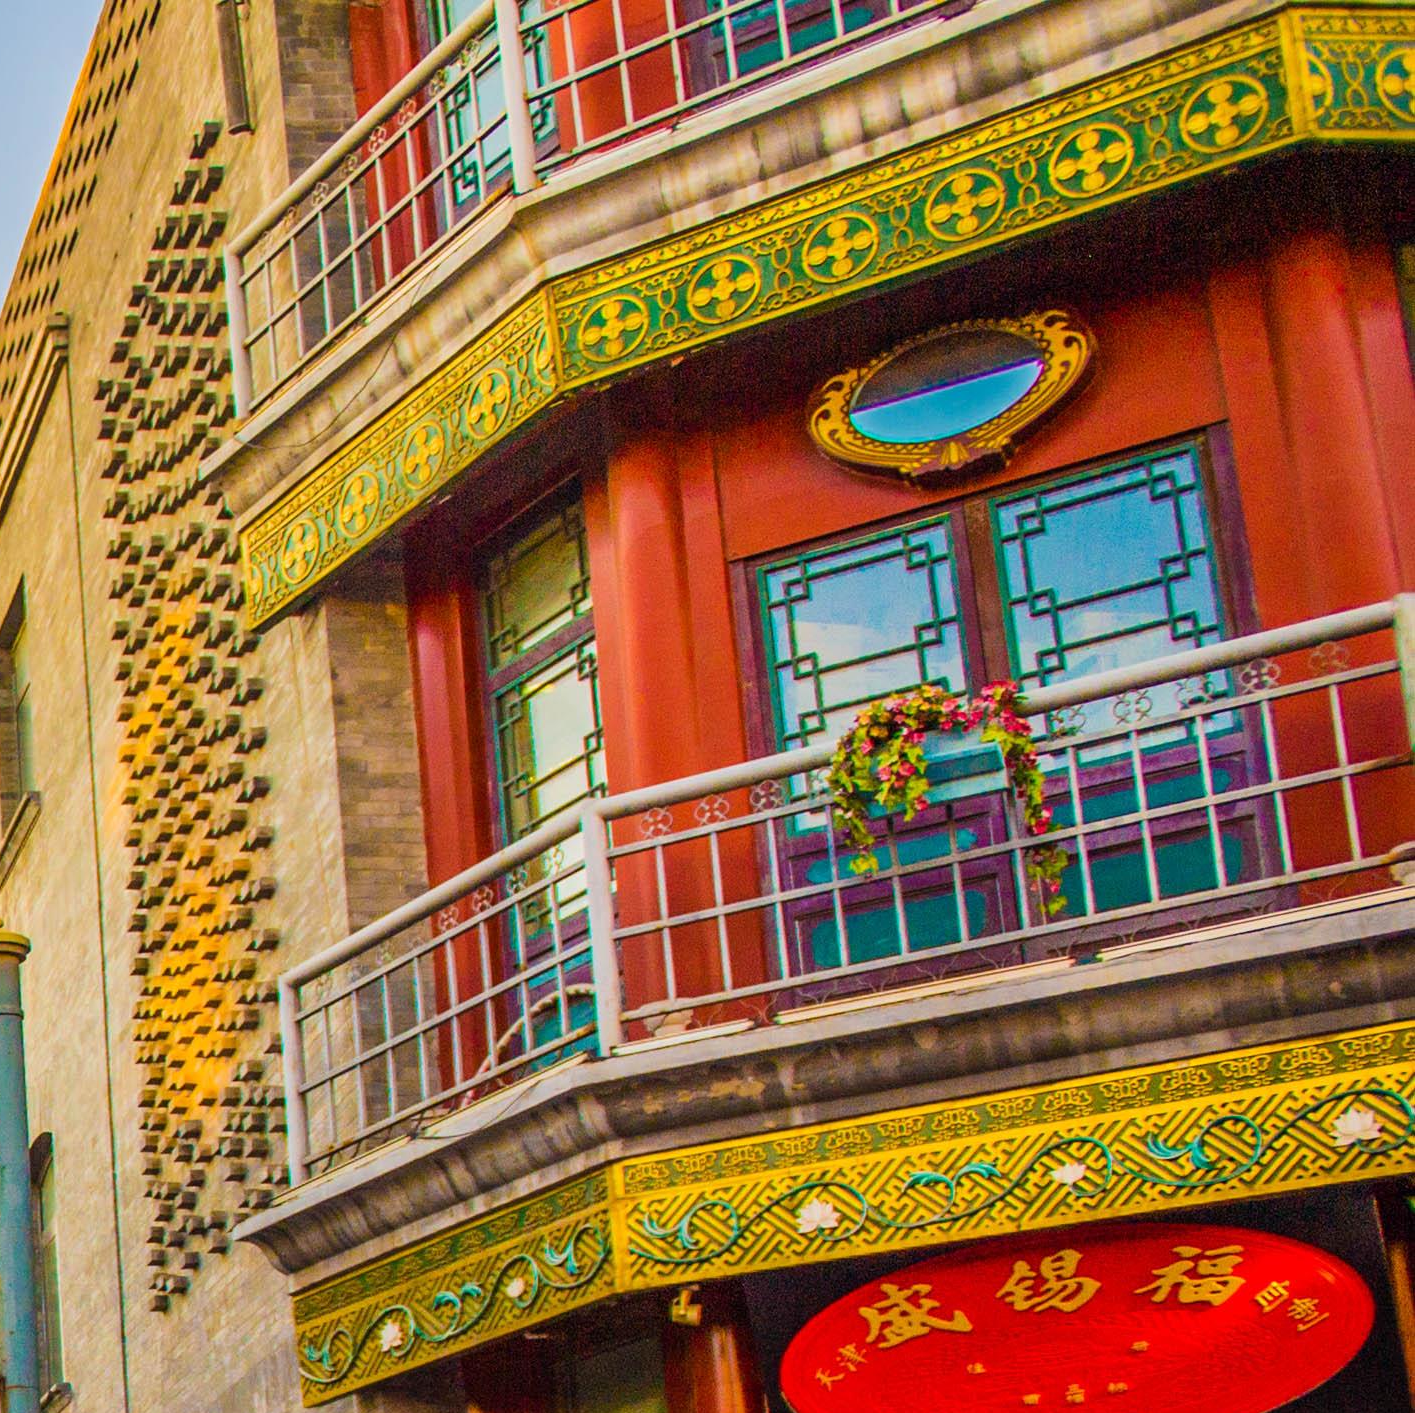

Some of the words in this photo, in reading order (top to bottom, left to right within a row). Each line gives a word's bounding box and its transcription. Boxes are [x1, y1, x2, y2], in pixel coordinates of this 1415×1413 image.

[814, 1343, 868, 1391] 天津
[859, 1245, 1247, 1349] 盛锡福
